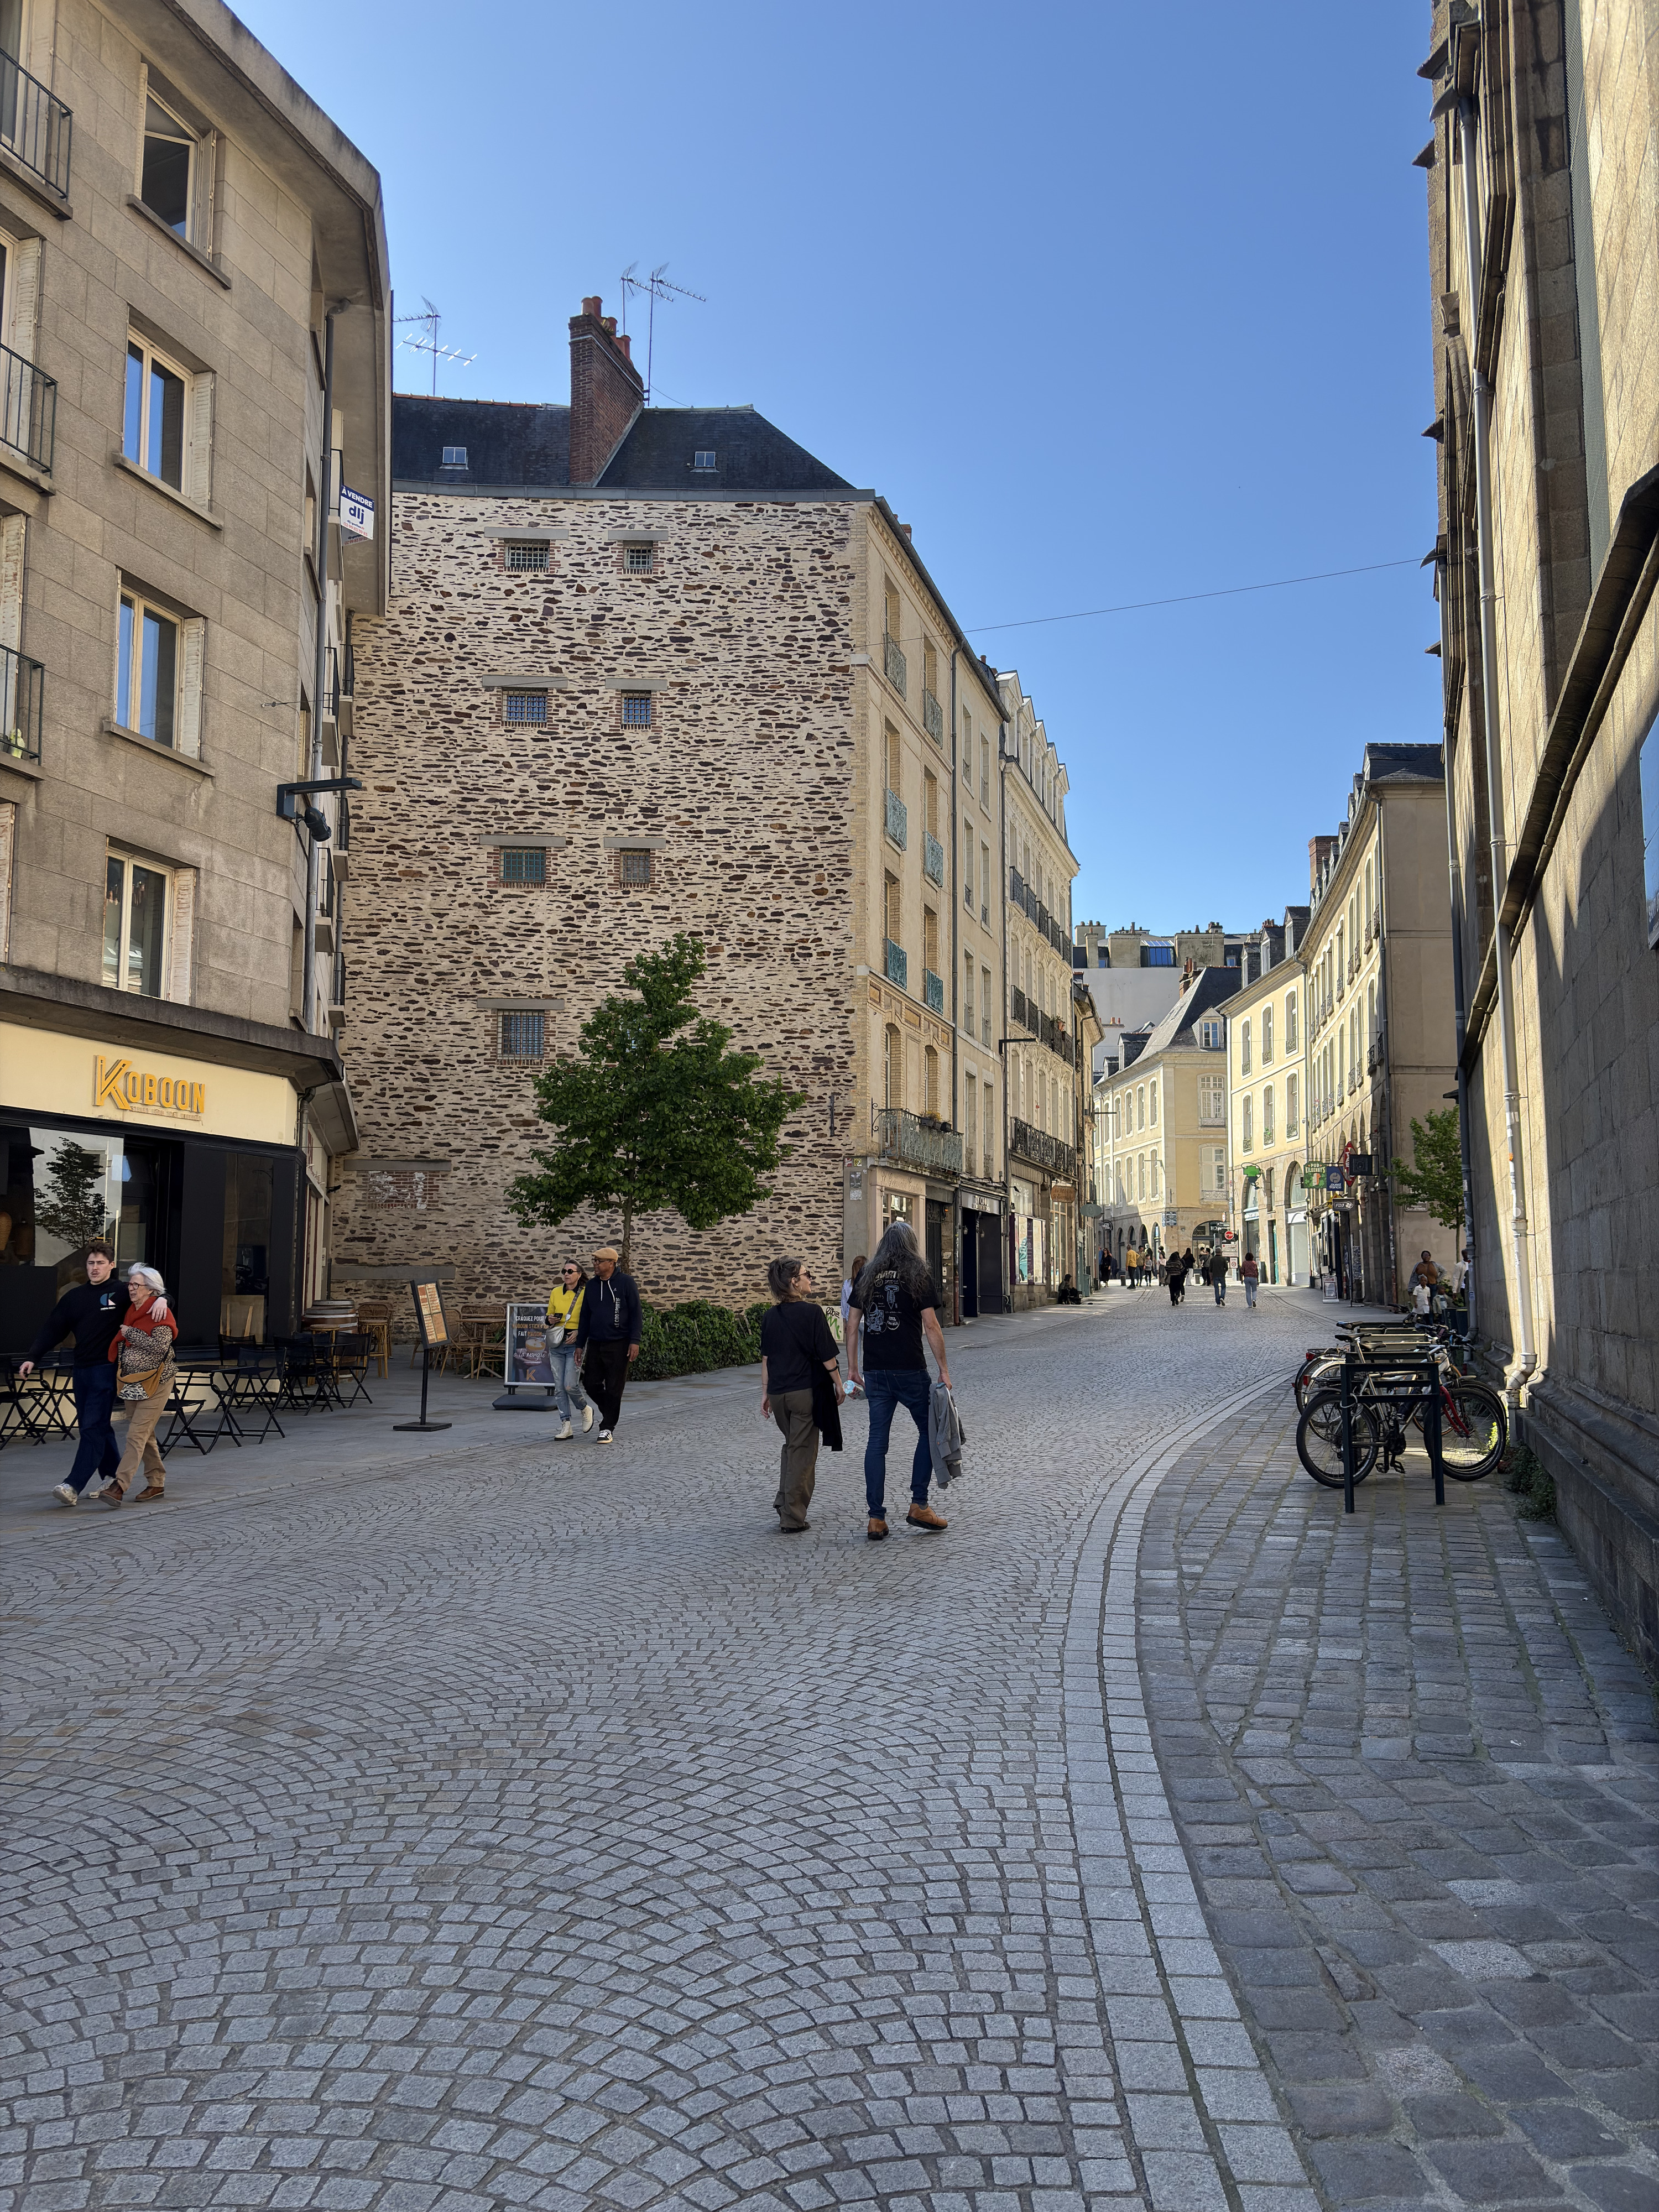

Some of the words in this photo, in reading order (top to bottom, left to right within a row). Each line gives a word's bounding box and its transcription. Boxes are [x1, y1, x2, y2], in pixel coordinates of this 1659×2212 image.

[347, 490, 373, 508] VENDRE
[349, 505, 364, 525] dlj
[95, 1055, 205, 1113] KOBOON
